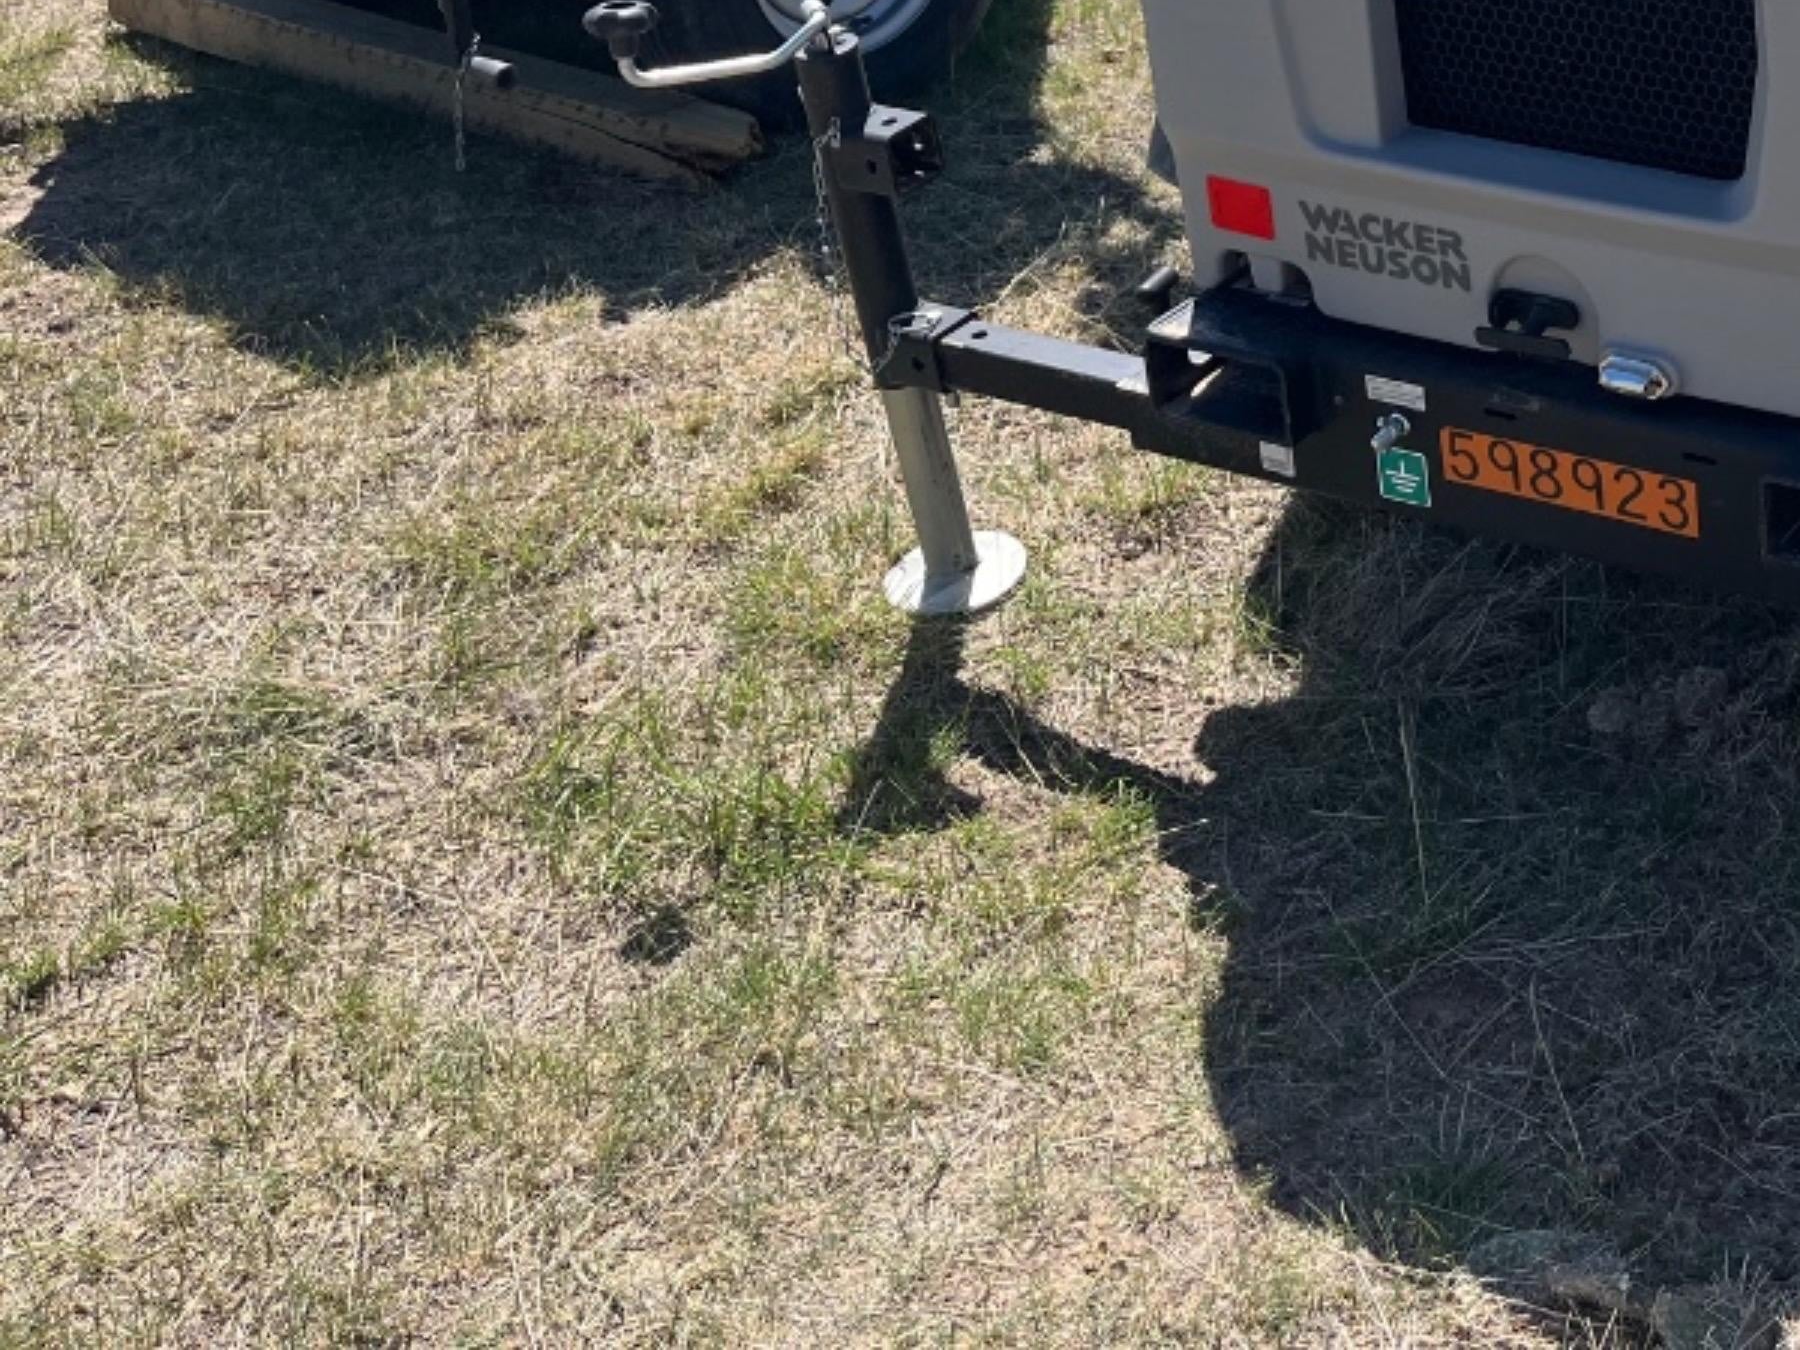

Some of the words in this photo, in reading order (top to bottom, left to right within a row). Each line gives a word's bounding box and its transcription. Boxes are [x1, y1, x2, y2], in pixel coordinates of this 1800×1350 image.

[1298, 199, 1468, 262] WACKER
[1304, 231, 1473, 293] NEUSON
[1449, 431, 1690, 531] 598923
